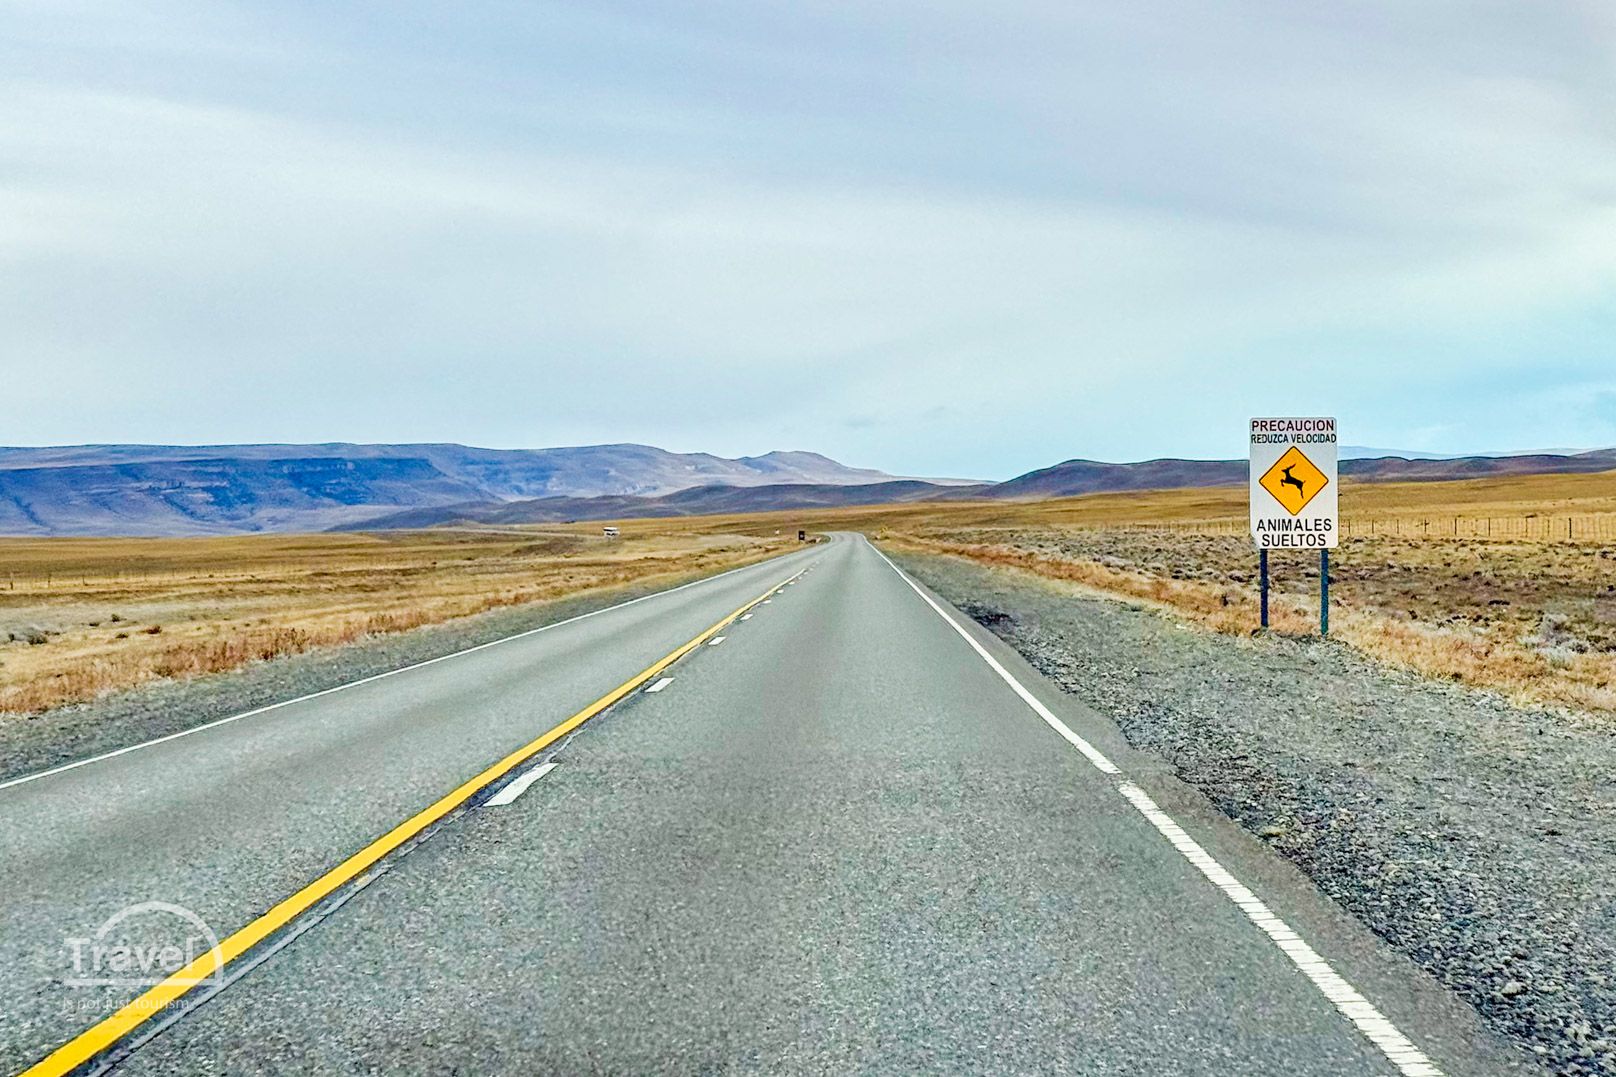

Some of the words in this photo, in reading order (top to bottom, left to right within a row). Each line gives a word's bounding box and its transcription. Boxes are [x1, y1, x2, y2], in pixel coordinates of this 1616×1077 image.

[1251, 420, 1334, 432] PRECAUCION
[1251, 433, 1289, 443] REDUZCA
[1291, 433, 1337, 443] VELOCIDAD
[1256, 518, 1332, 532] ANIMALES
[1261, 534, 1326, 547] SUELTOS
